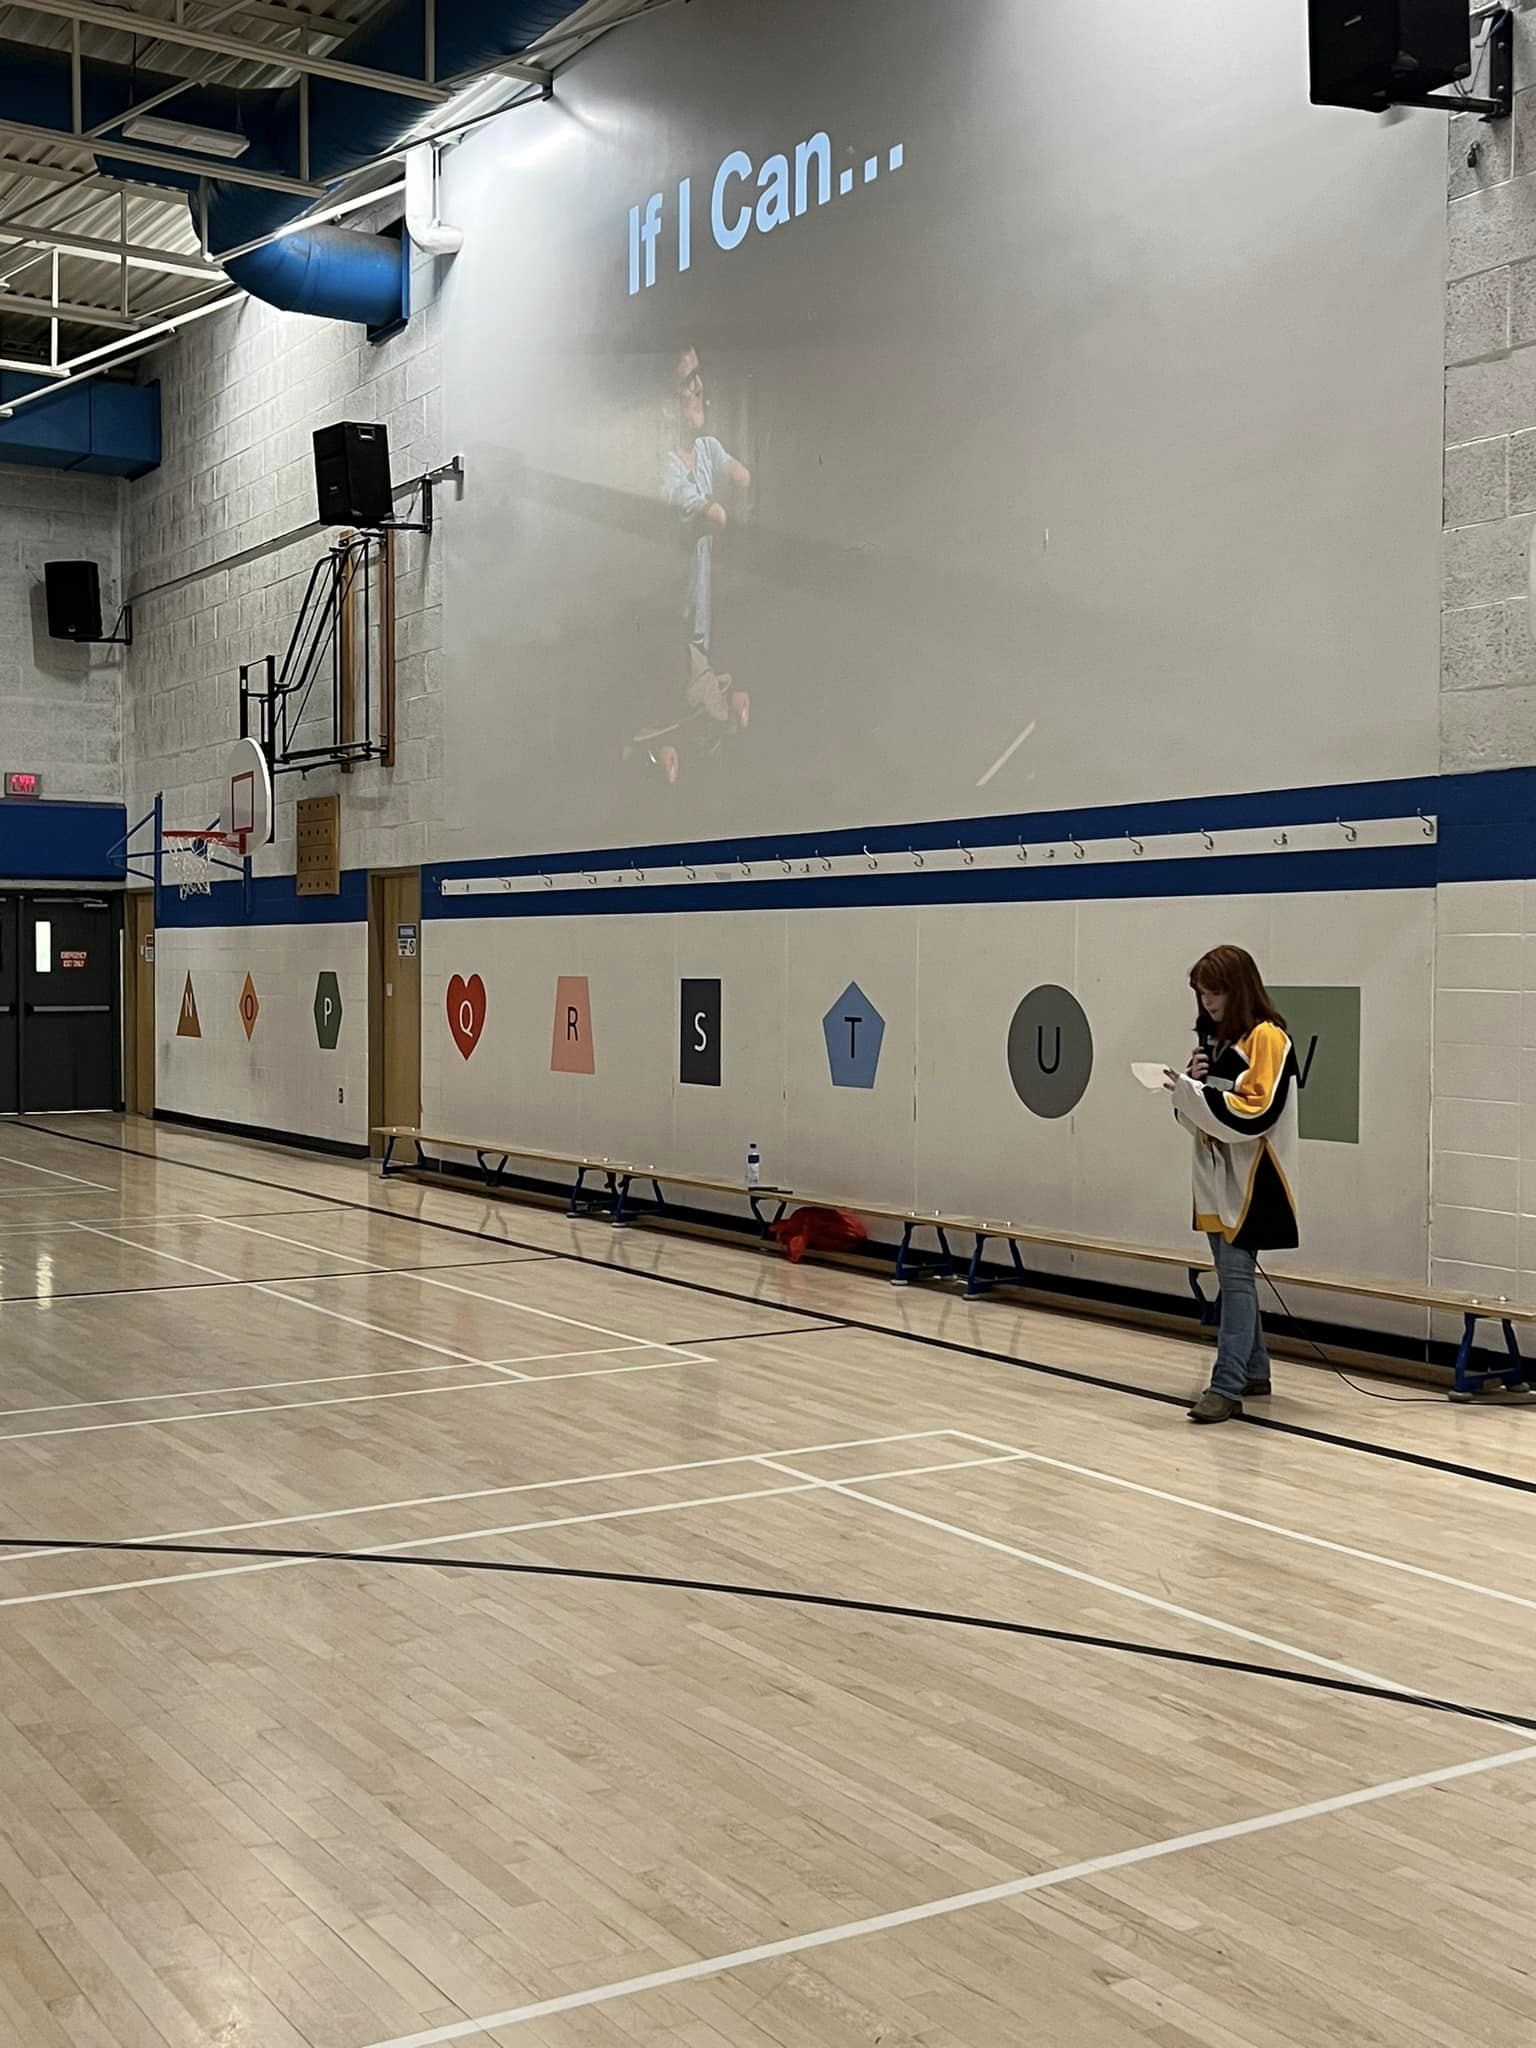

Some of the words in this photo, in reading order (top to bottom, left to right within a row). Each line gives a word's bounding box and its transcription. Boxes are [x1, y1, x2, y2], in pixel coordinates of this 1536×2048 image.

[628, 192, 663, 296] If
[678, 177, 690, 272] I
[711, 131, 904, 251] Can...
[184, 991, 194, 1018] N
[244, 994, 254, 1021] O
[323, 996, 333, 1027] P
[458, 999, 474, 1038] Q
[567, 1006, 579, 1041] R
[693, 1011, 708, 1052] S
[844, 1016, 863, 1059] T
[1037, 1024, 1061, 1075] U
